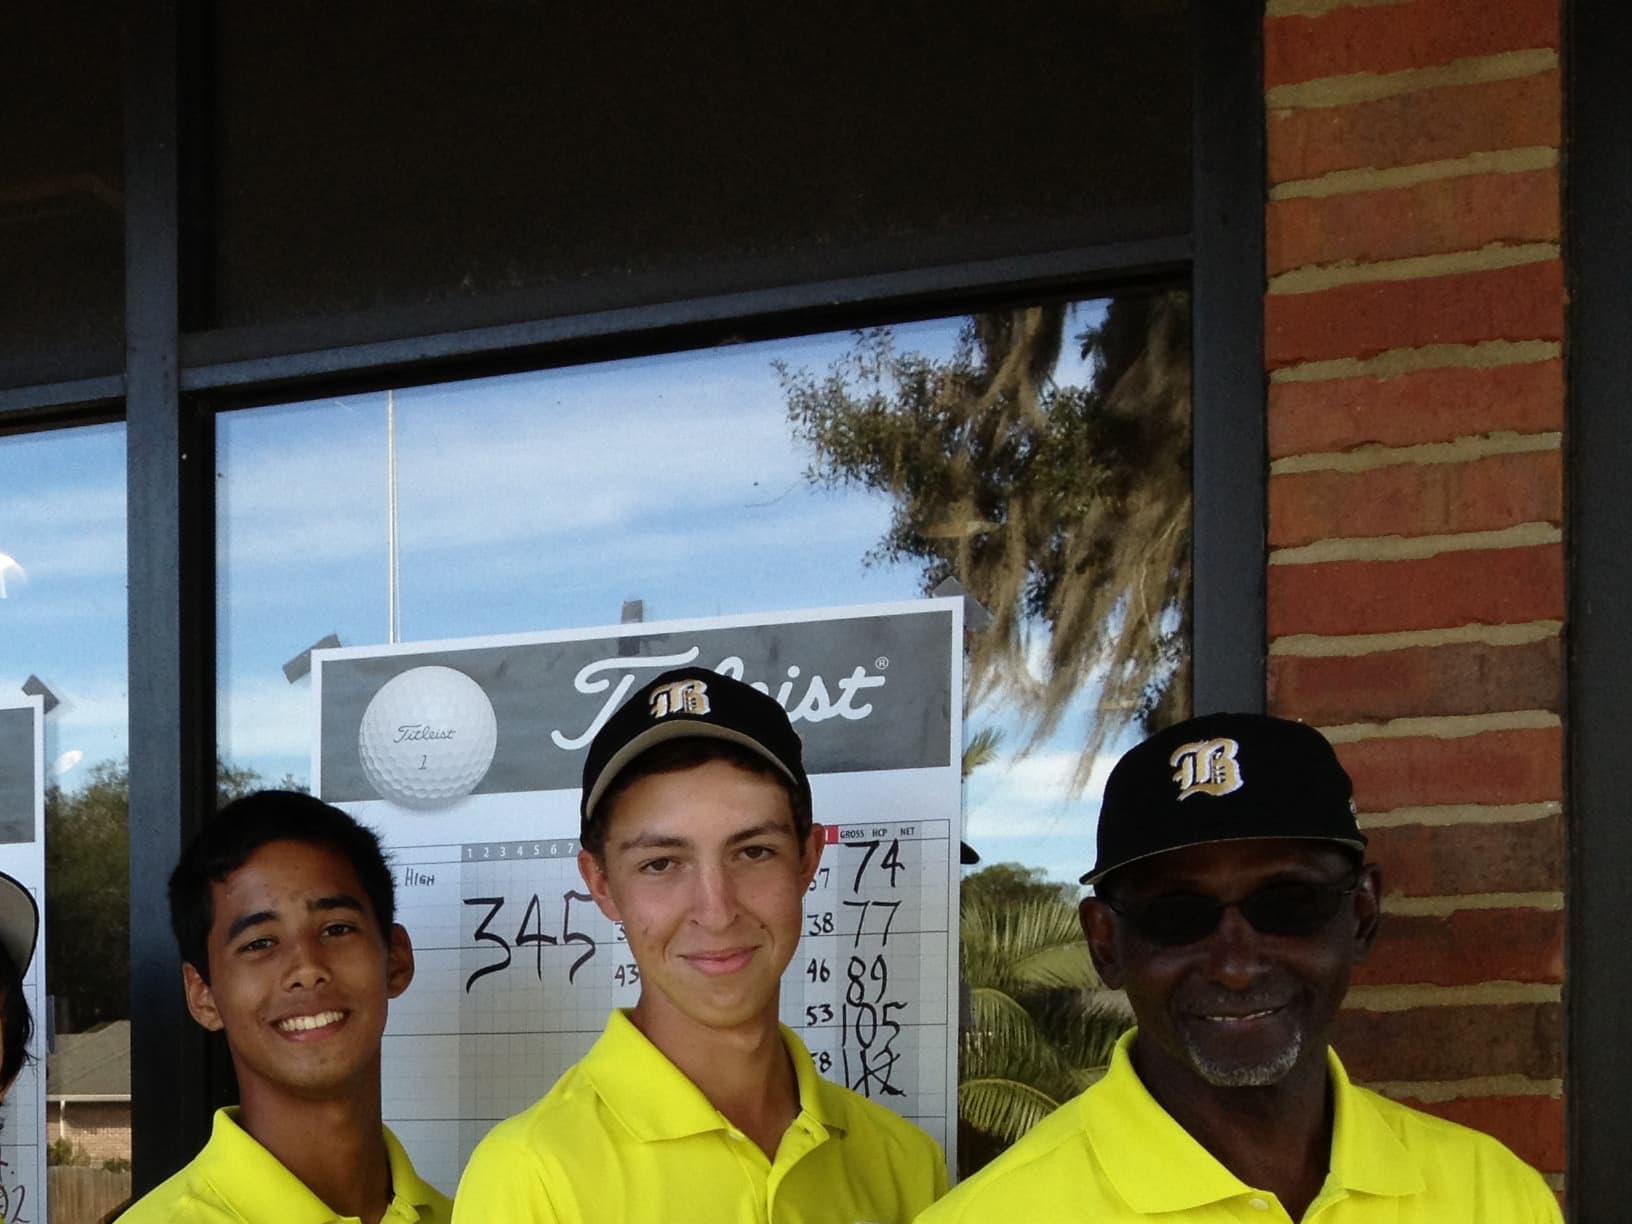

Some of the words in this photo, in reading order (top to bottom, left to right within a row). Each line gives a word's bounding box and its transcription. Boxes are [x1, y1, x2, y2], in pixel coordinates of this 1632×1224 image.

[393, 724, 456, 743] Titleist
[840, 830, 864, 838] GROSS
[900, 827, 915, 835] NET
[404, 867, 435, 887] HIGH
[845, 838, 905, 894] 74
[807, 912, 834, 936] 38
[843, 900, 901, 948] 77
[464, 890, 595, 994] 345
[614, 964, 639, 987] 43
[807, 958, 830, 982] 46
[846, 954, 887, 1007] 89
[806, 1003, 833, 1026] 53
[842, 1002, 908, 1050] 105
